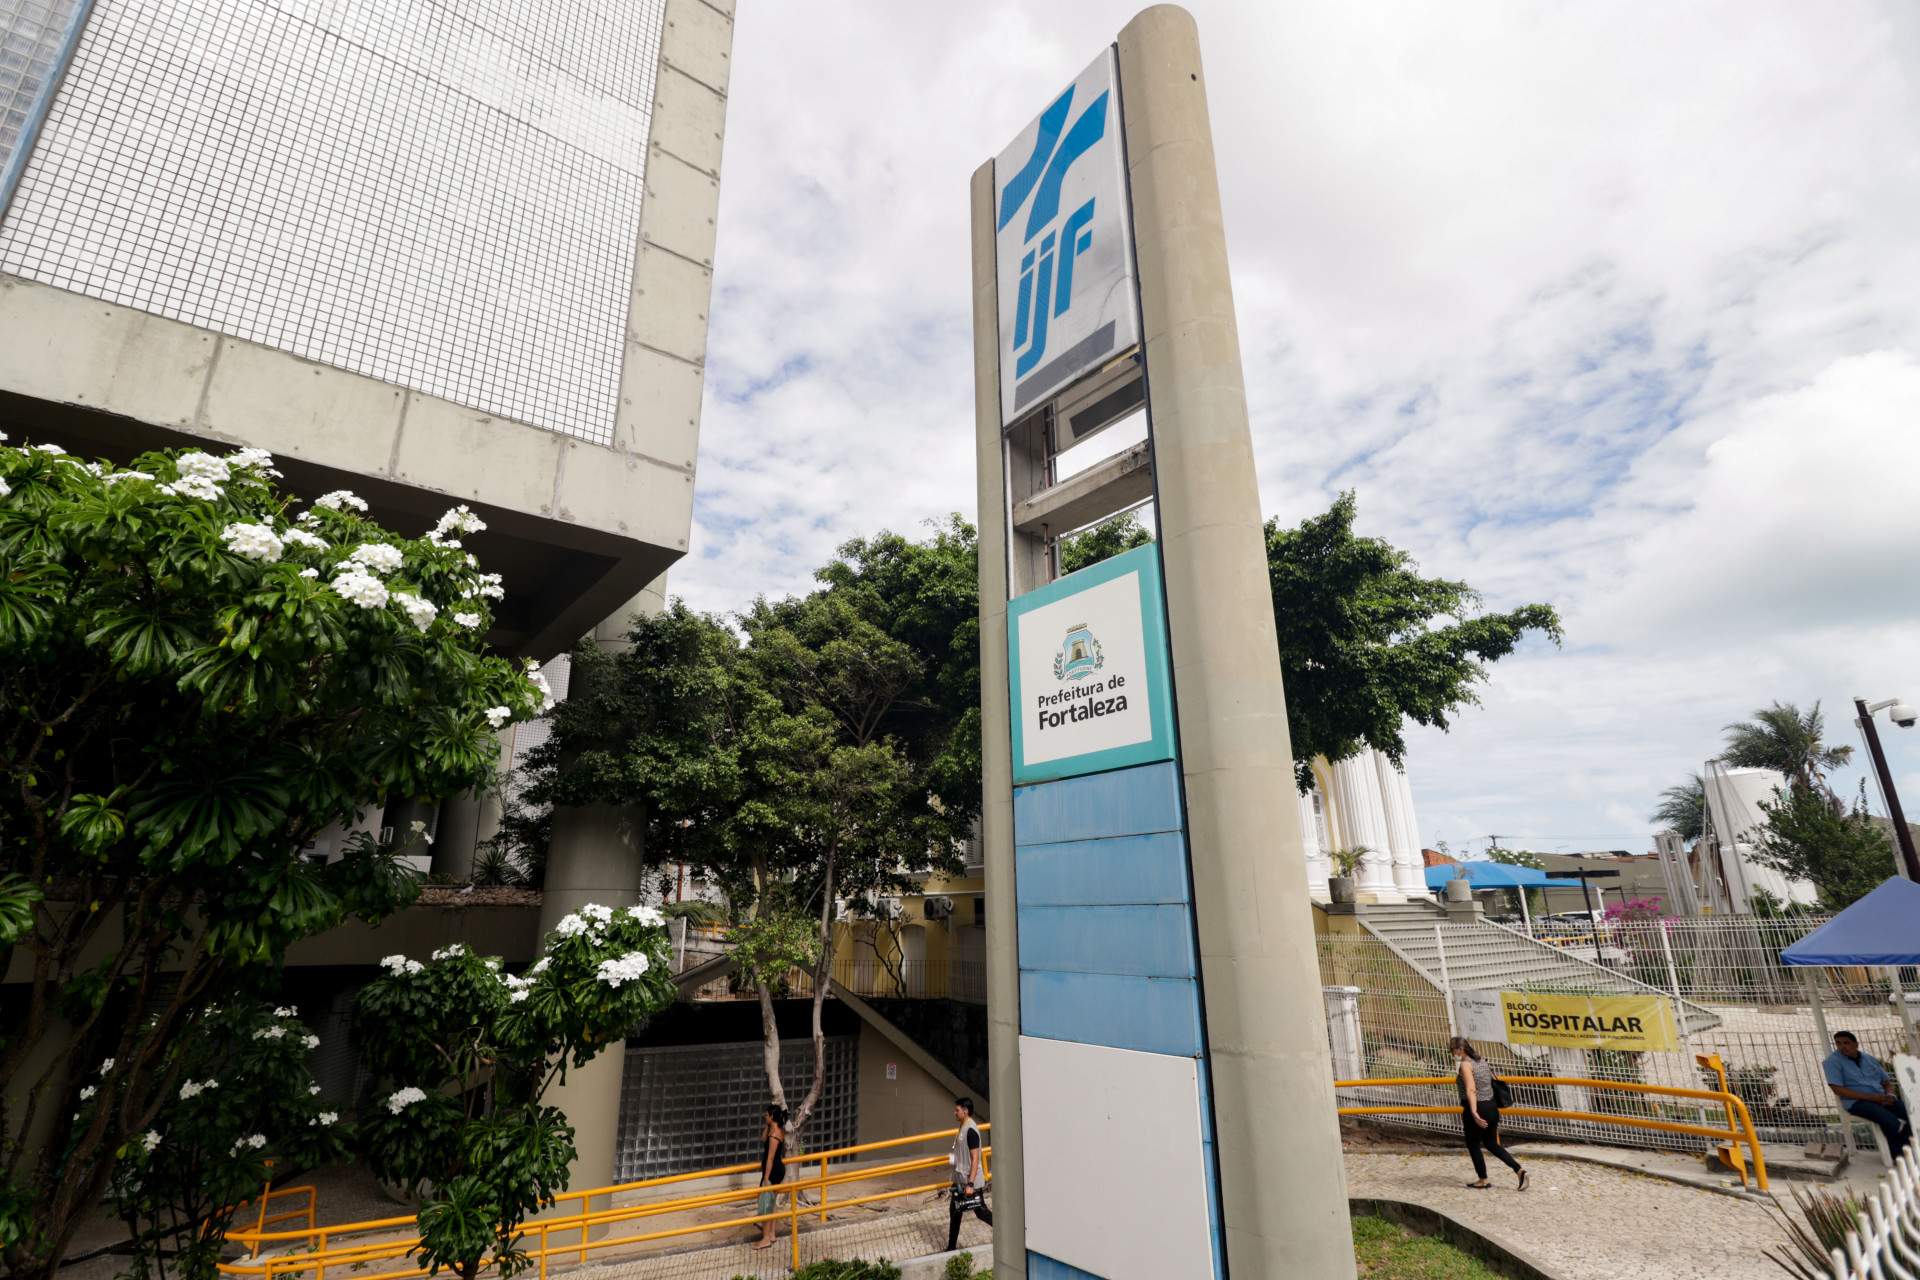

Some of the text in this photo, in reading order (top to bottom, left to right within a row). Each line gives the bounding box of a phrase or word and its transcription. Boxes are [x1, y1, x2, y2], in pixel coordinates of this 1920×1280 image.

[1013, 196, 1095, 381] ijf
[1038, 675, 1125, 708] Prefeitura de
[1039, 695, 1127, 730] Fortaleza
[1506, 1002, 1538, 1011] BLOCO
[1509, 1012, 1643, 1033] HOSPITALAR
